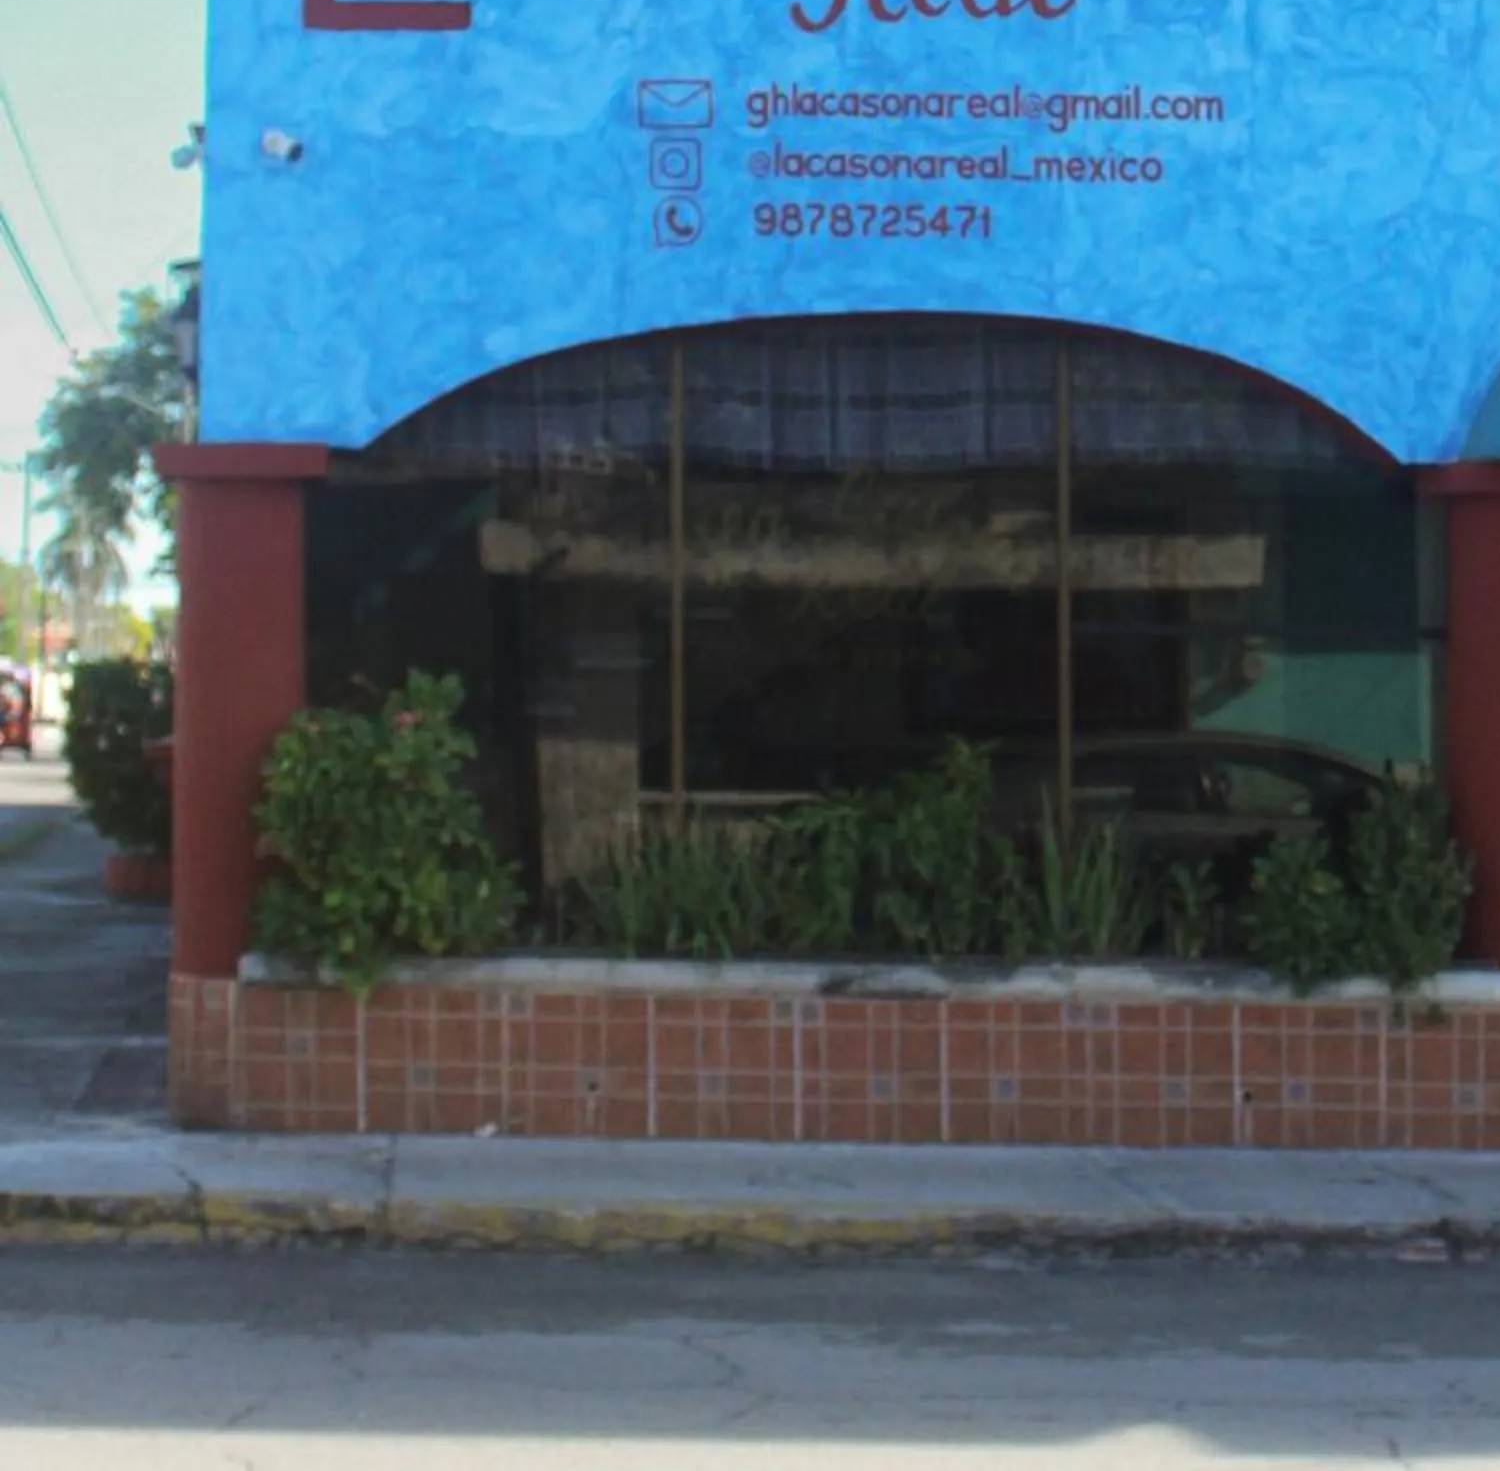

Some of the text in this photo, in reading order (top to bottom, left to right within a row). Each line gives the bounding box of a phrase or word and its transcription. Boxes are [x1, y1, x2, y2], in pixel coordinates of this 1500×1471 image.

[745, 82, 1225, 134] ghlacasonareal@gmail.com
[748, 141, 1164, 183] @lacasonareal_mexico
[753, 202, 993, 239] 9878725471
